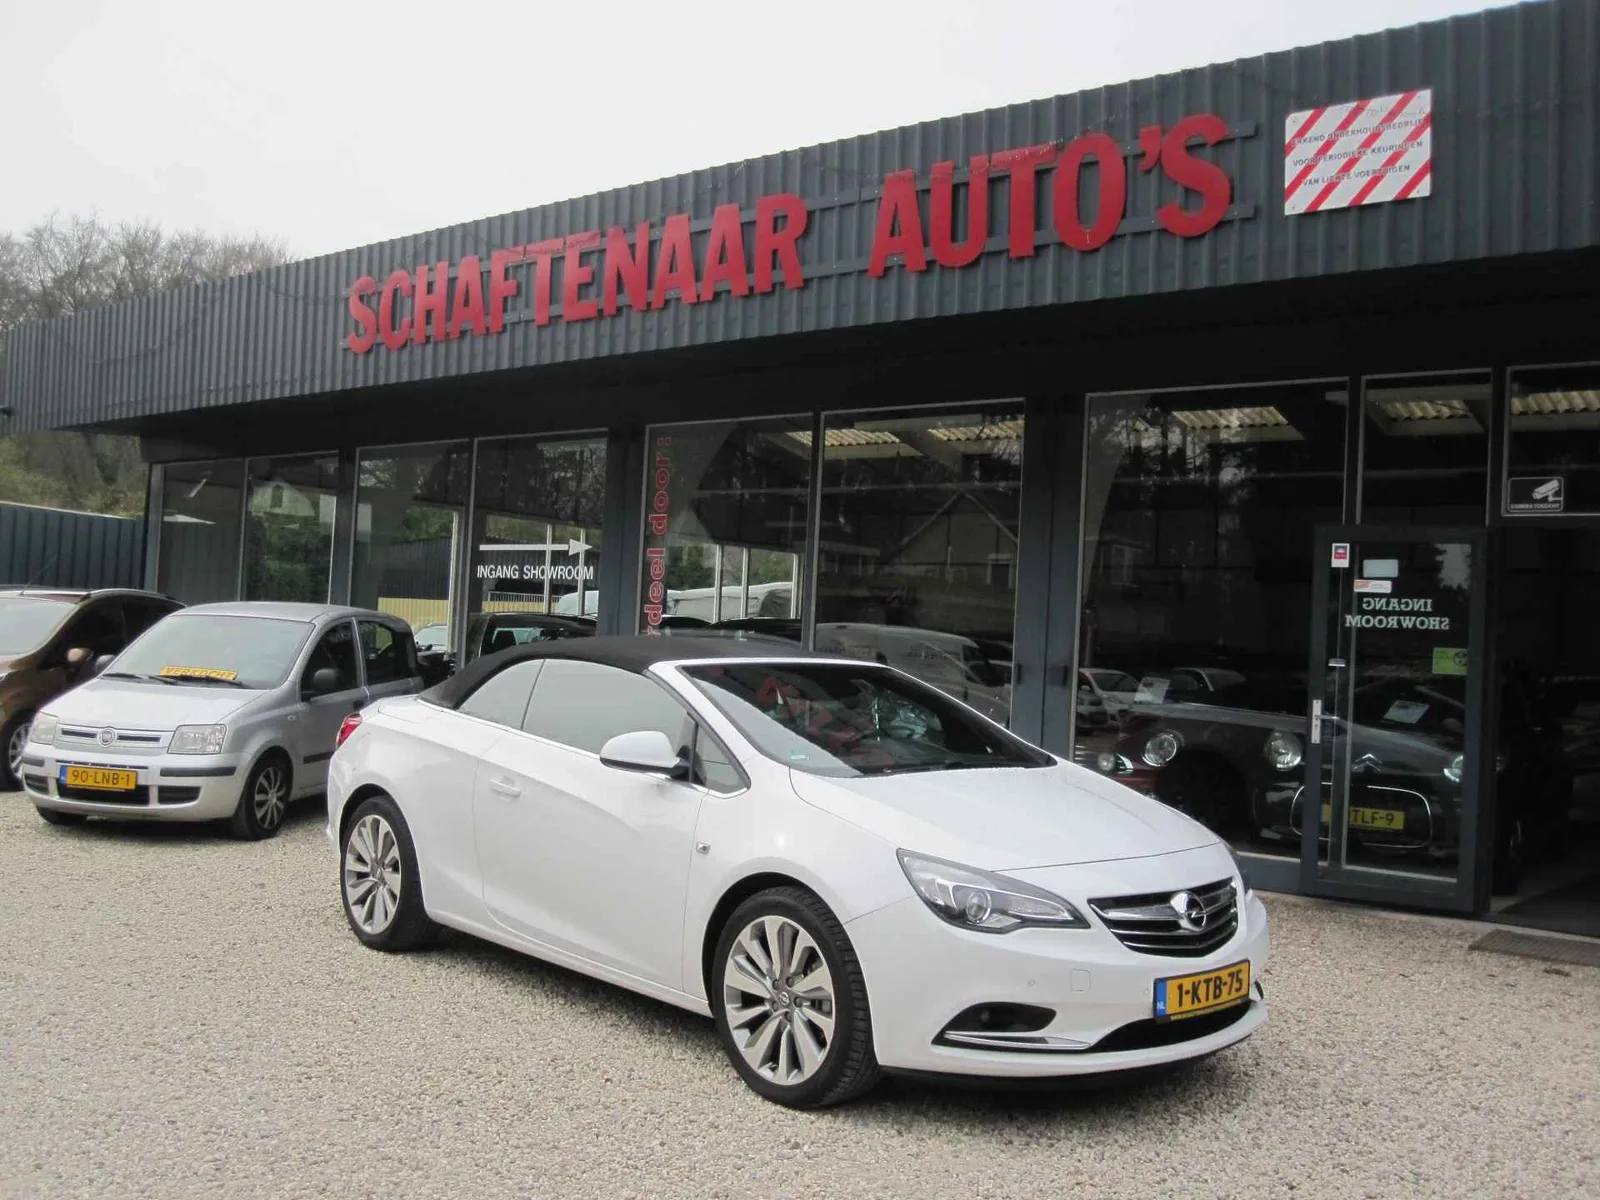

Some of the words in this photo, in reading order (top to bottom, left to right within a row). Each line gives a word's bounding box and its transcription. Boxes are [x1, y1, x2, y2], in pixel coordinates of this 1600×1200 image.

[1292, 135, 1325, 146] ERKEND
[1293, 157, 1318, 166] VOOR
[1371, 141, 1423, 154] KEURINGEN
[1303, 178, 1320, 187] VAN
[1354, 165, 1411, 178] VOERTUIGEN
[347, 192, 808, 354] SCHAFTENAAR
[868, 113, 1233, 278] AUTO'S
[477, 565, 519, 579] INGANG
[523, 565, 594, 580] SHOWROOM
[72, 769, 131, 786] 90-LNB-1
[1177, 969, 1243, 1008] 1-KTB-75
